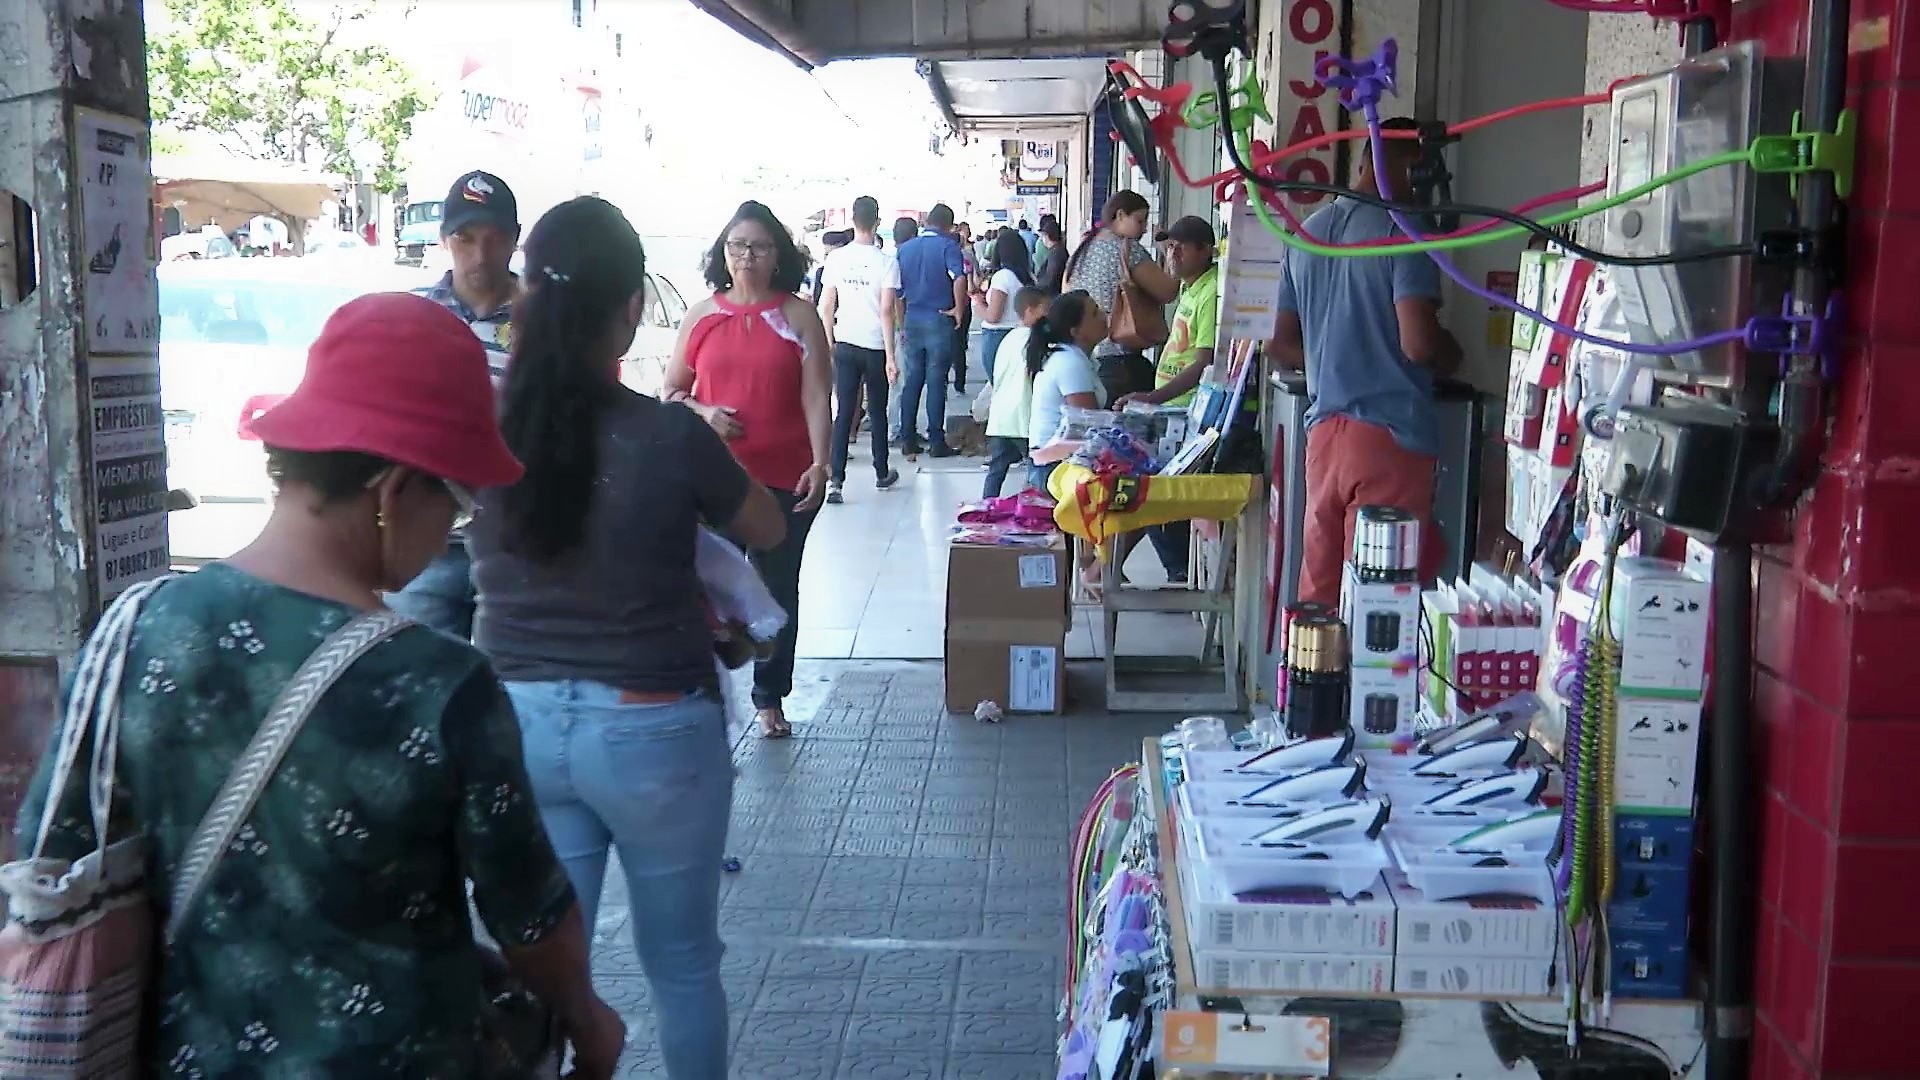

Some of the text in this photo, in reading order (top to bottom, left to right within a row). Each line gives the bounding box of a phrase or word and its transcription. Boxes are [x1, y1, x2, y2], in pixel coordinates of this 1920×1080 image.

[95, 400, 160, 432] EMPRÉSTI
[98, 464, 139, 487] MENOR
[101, 531, 128, 551] Ligue
[131, 530, 137, 542] e
